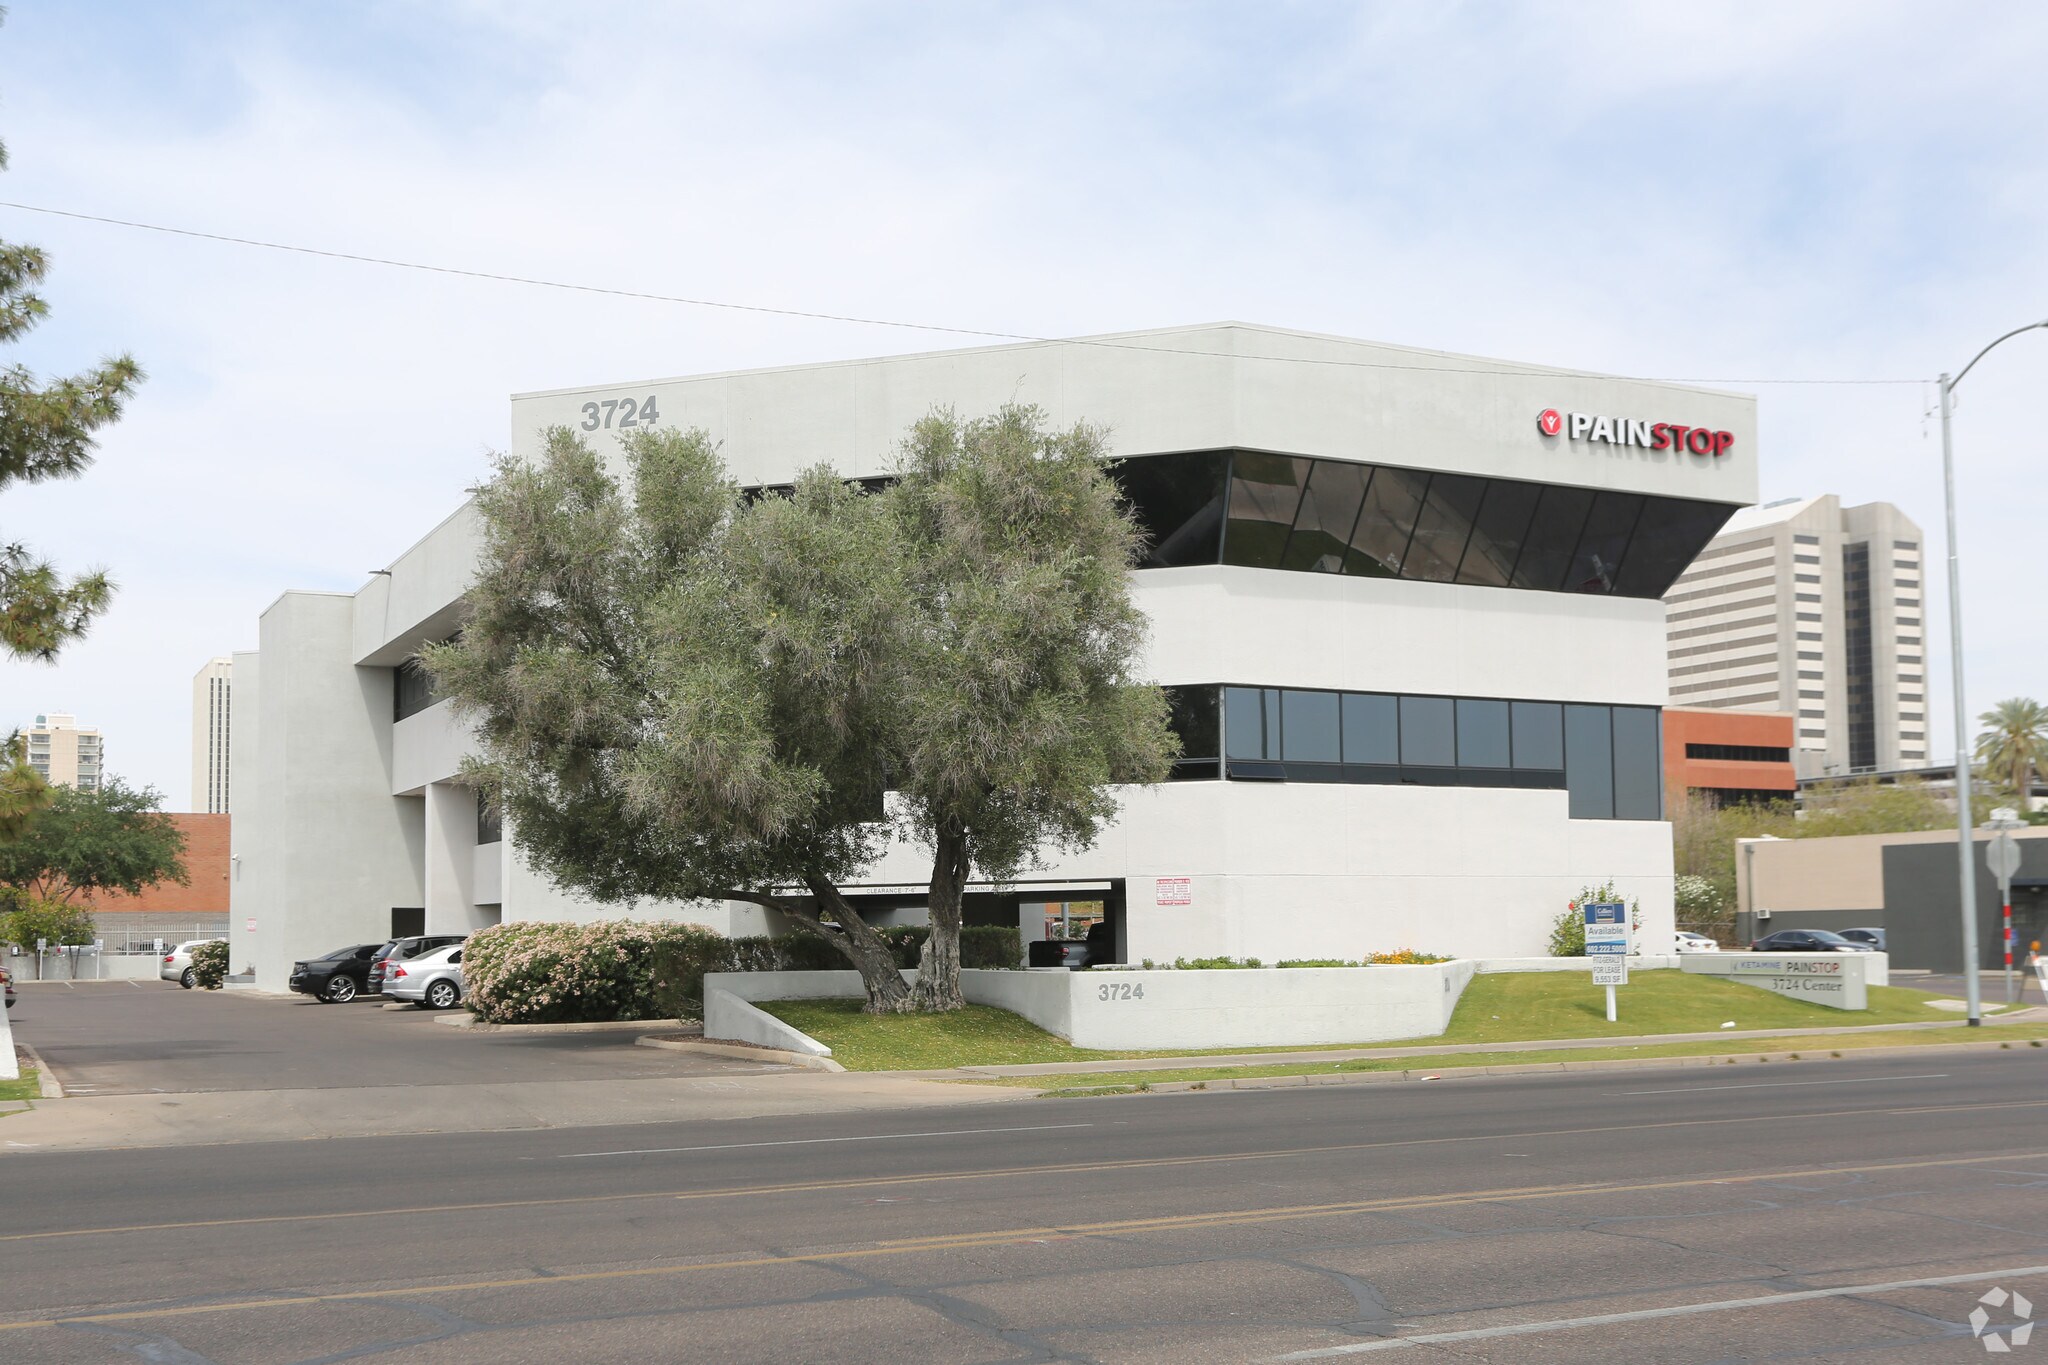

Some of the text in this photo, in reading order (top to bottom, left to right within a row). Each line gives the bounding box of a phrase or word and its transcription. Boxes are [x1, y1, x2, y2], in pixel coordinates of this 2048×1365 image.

[581, 395, 660, 432] 3724
[1569, 412, 1735, 456] PAINSTOP
[1588, 926, 1624, 935] Available
[1741, 961, 1781, 969] KETAMINE
[1786, 962, 1840, 973] PAINSTOP
[1772, 978, 1842, 991] 3724 Center
[1098, 982, 1144, 1001] 3724
